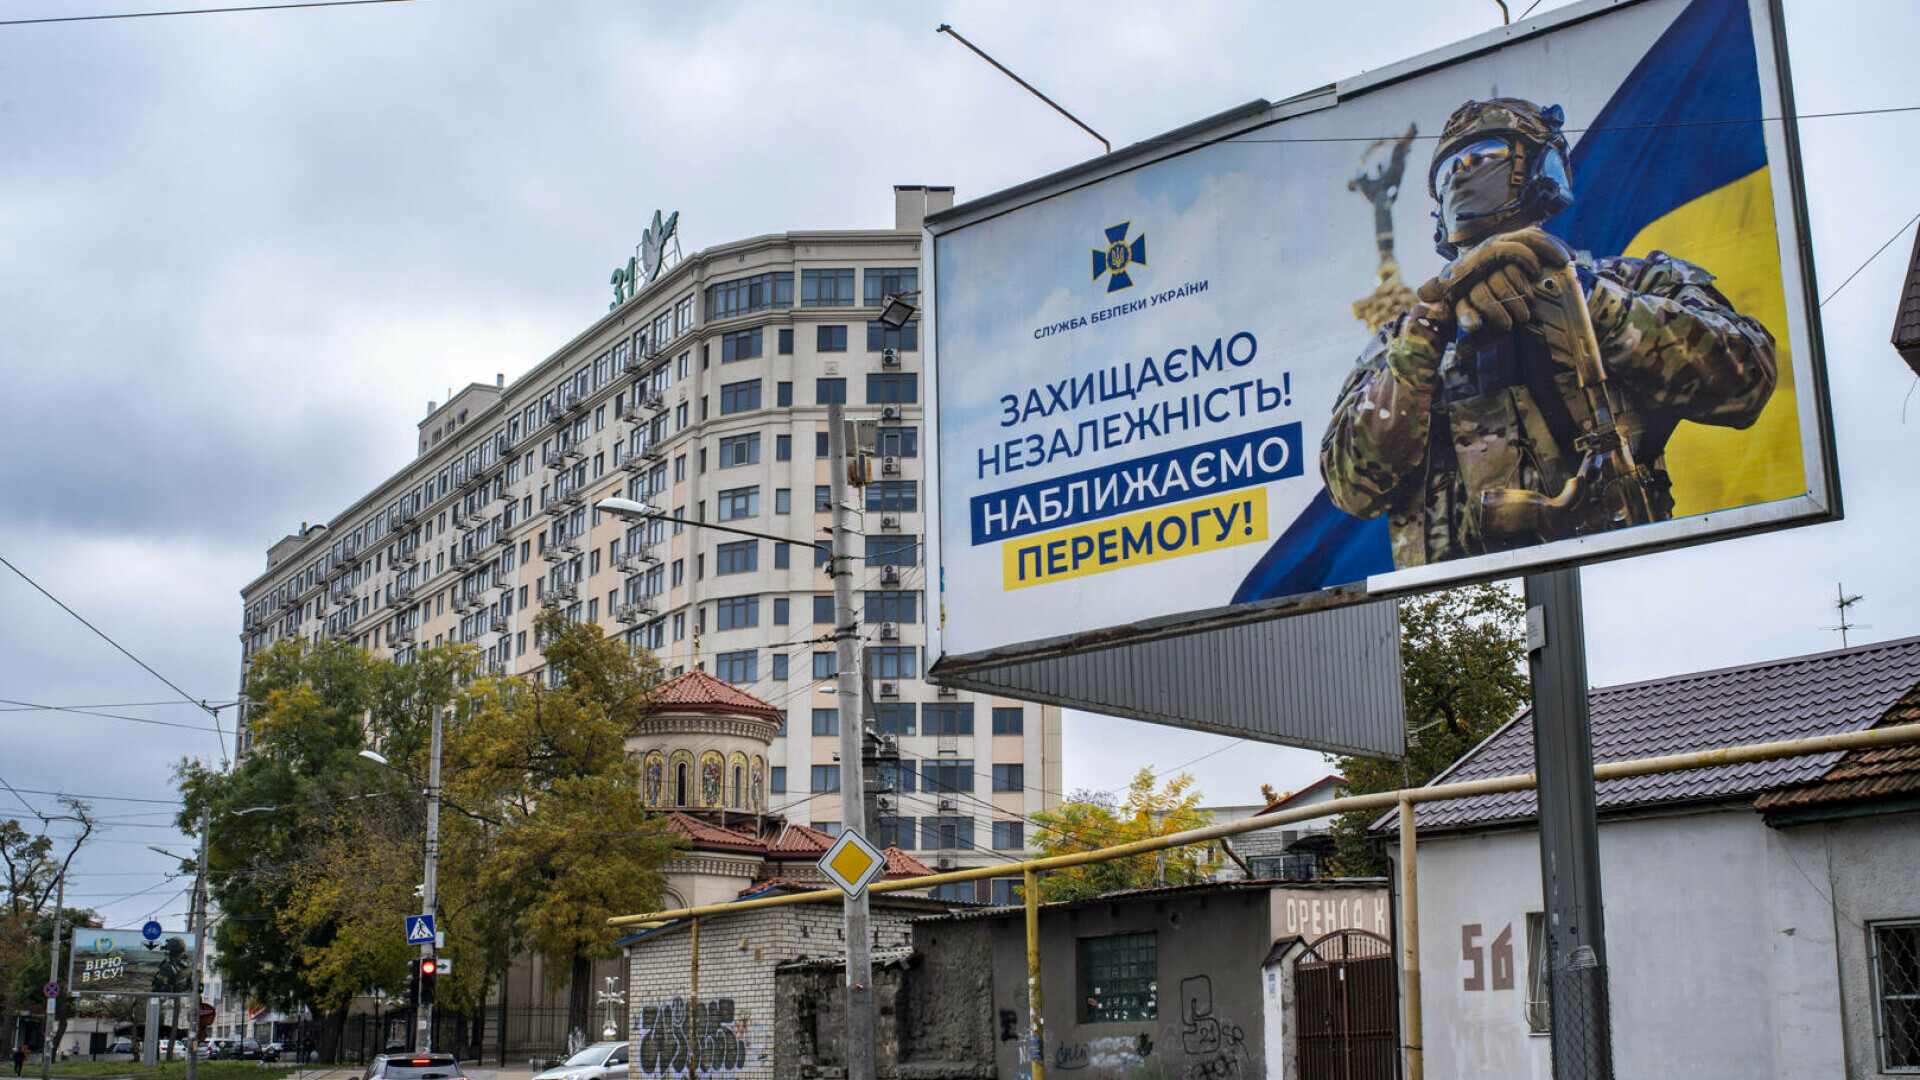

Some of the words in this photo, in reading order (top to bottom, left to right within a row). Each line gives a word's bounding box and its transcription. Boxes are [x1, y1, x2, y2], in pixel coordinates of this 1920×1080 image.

[1034, 315, 1088, 340] СЛУЖБА
[1091, 298, 1147, 322] БЕЗПЕКИ
[1150, 280, 1209, 308] УКРАЇНИ
[1000, 332, 1257, 427] ЗАХИЩАЄМО
[978, 372, 1292, 479] НЕЗАЛЕЖНІСТЬ!
[984, 437, 1289, 535] НАБЛИЖАЄМО
[1018, 501, 1254, 581] ПЕРЕМОГУ!
[1286, 897, 1363, 935] ОРЕНДА
[82, 972, 91, 982] В
[94, 966, 124, 980] ЗСУ!
[85, 956, 122, 971] ВІРЮ
[1462, 922, 1515, 991] 56
